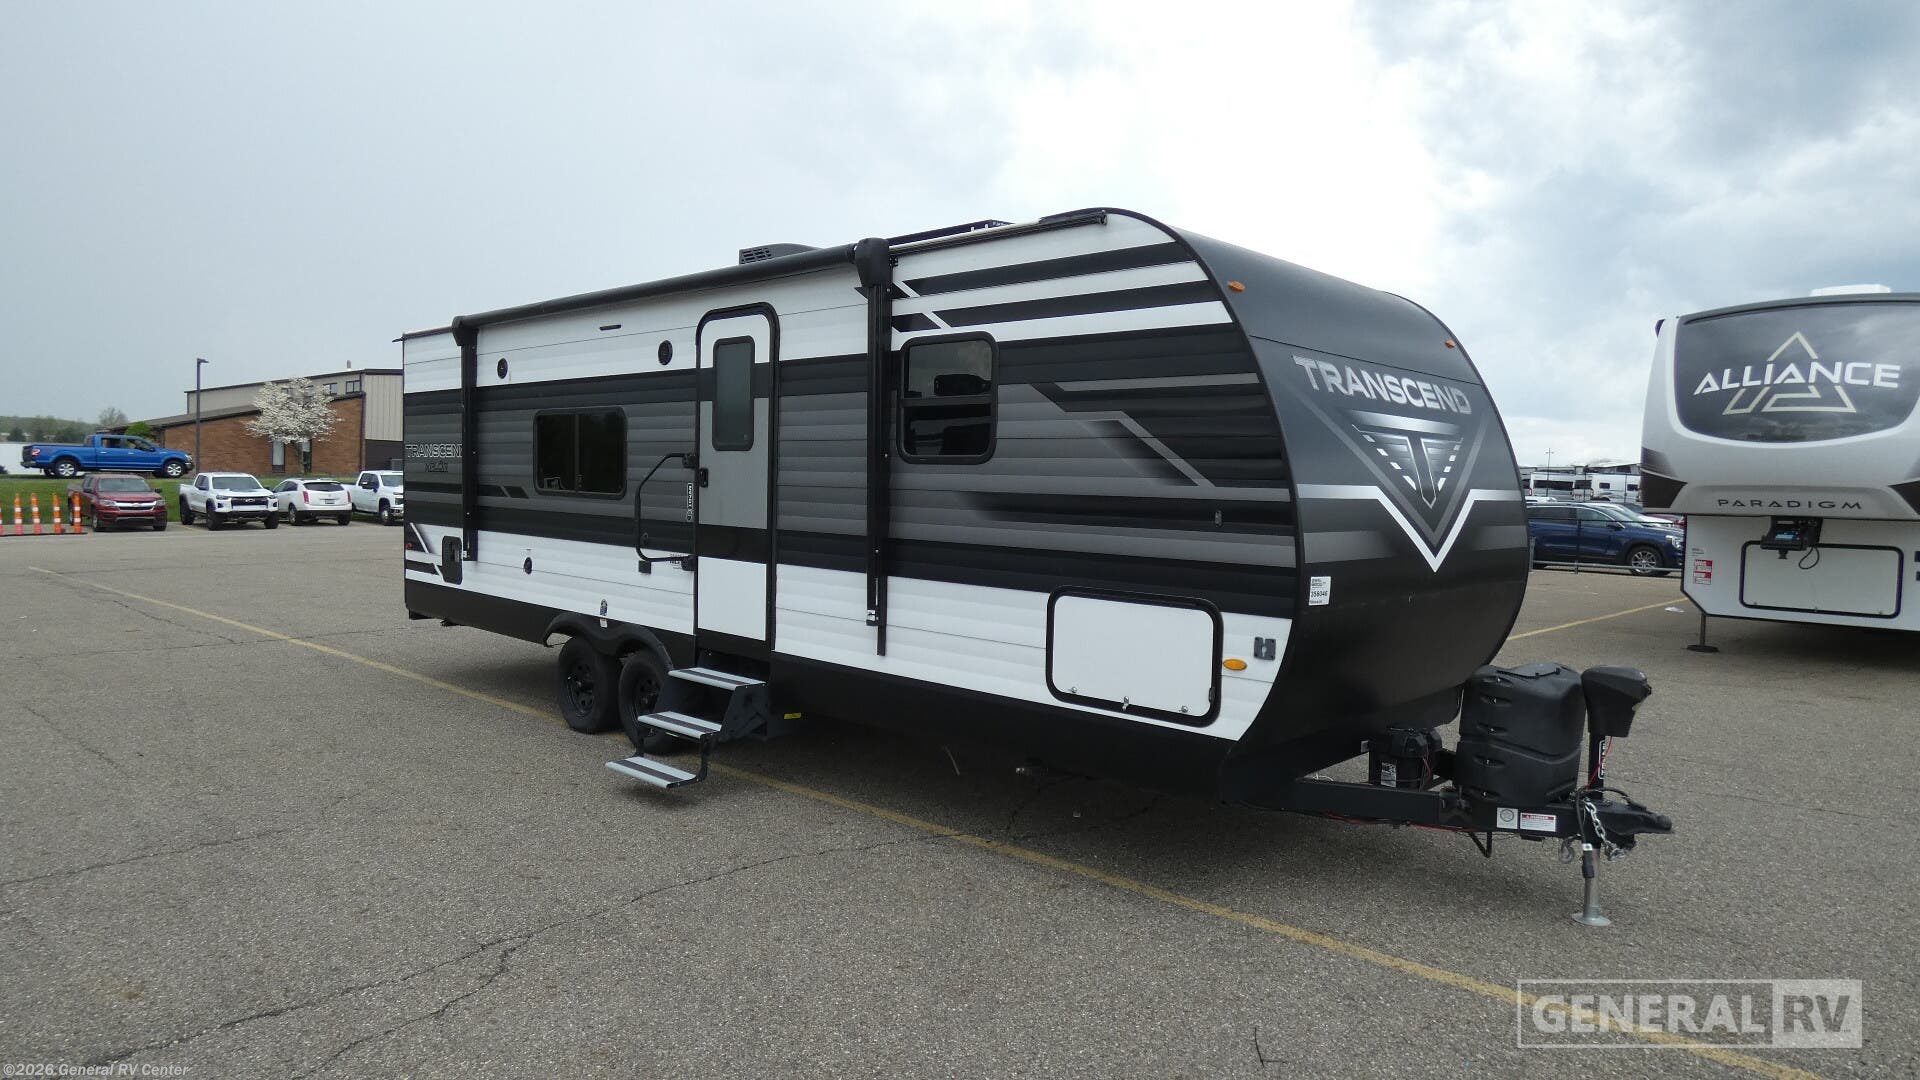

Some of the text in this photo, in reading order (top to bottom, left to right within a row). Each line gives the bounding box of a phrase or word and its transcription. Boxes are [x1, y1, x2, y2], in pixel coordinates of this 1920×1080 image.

[1293, 354, 1472, 415] TRANSCEND
[1693, 361, 1901, 396] ALLIANCE
[1718, 499, 1862, 510] PARADIGM
